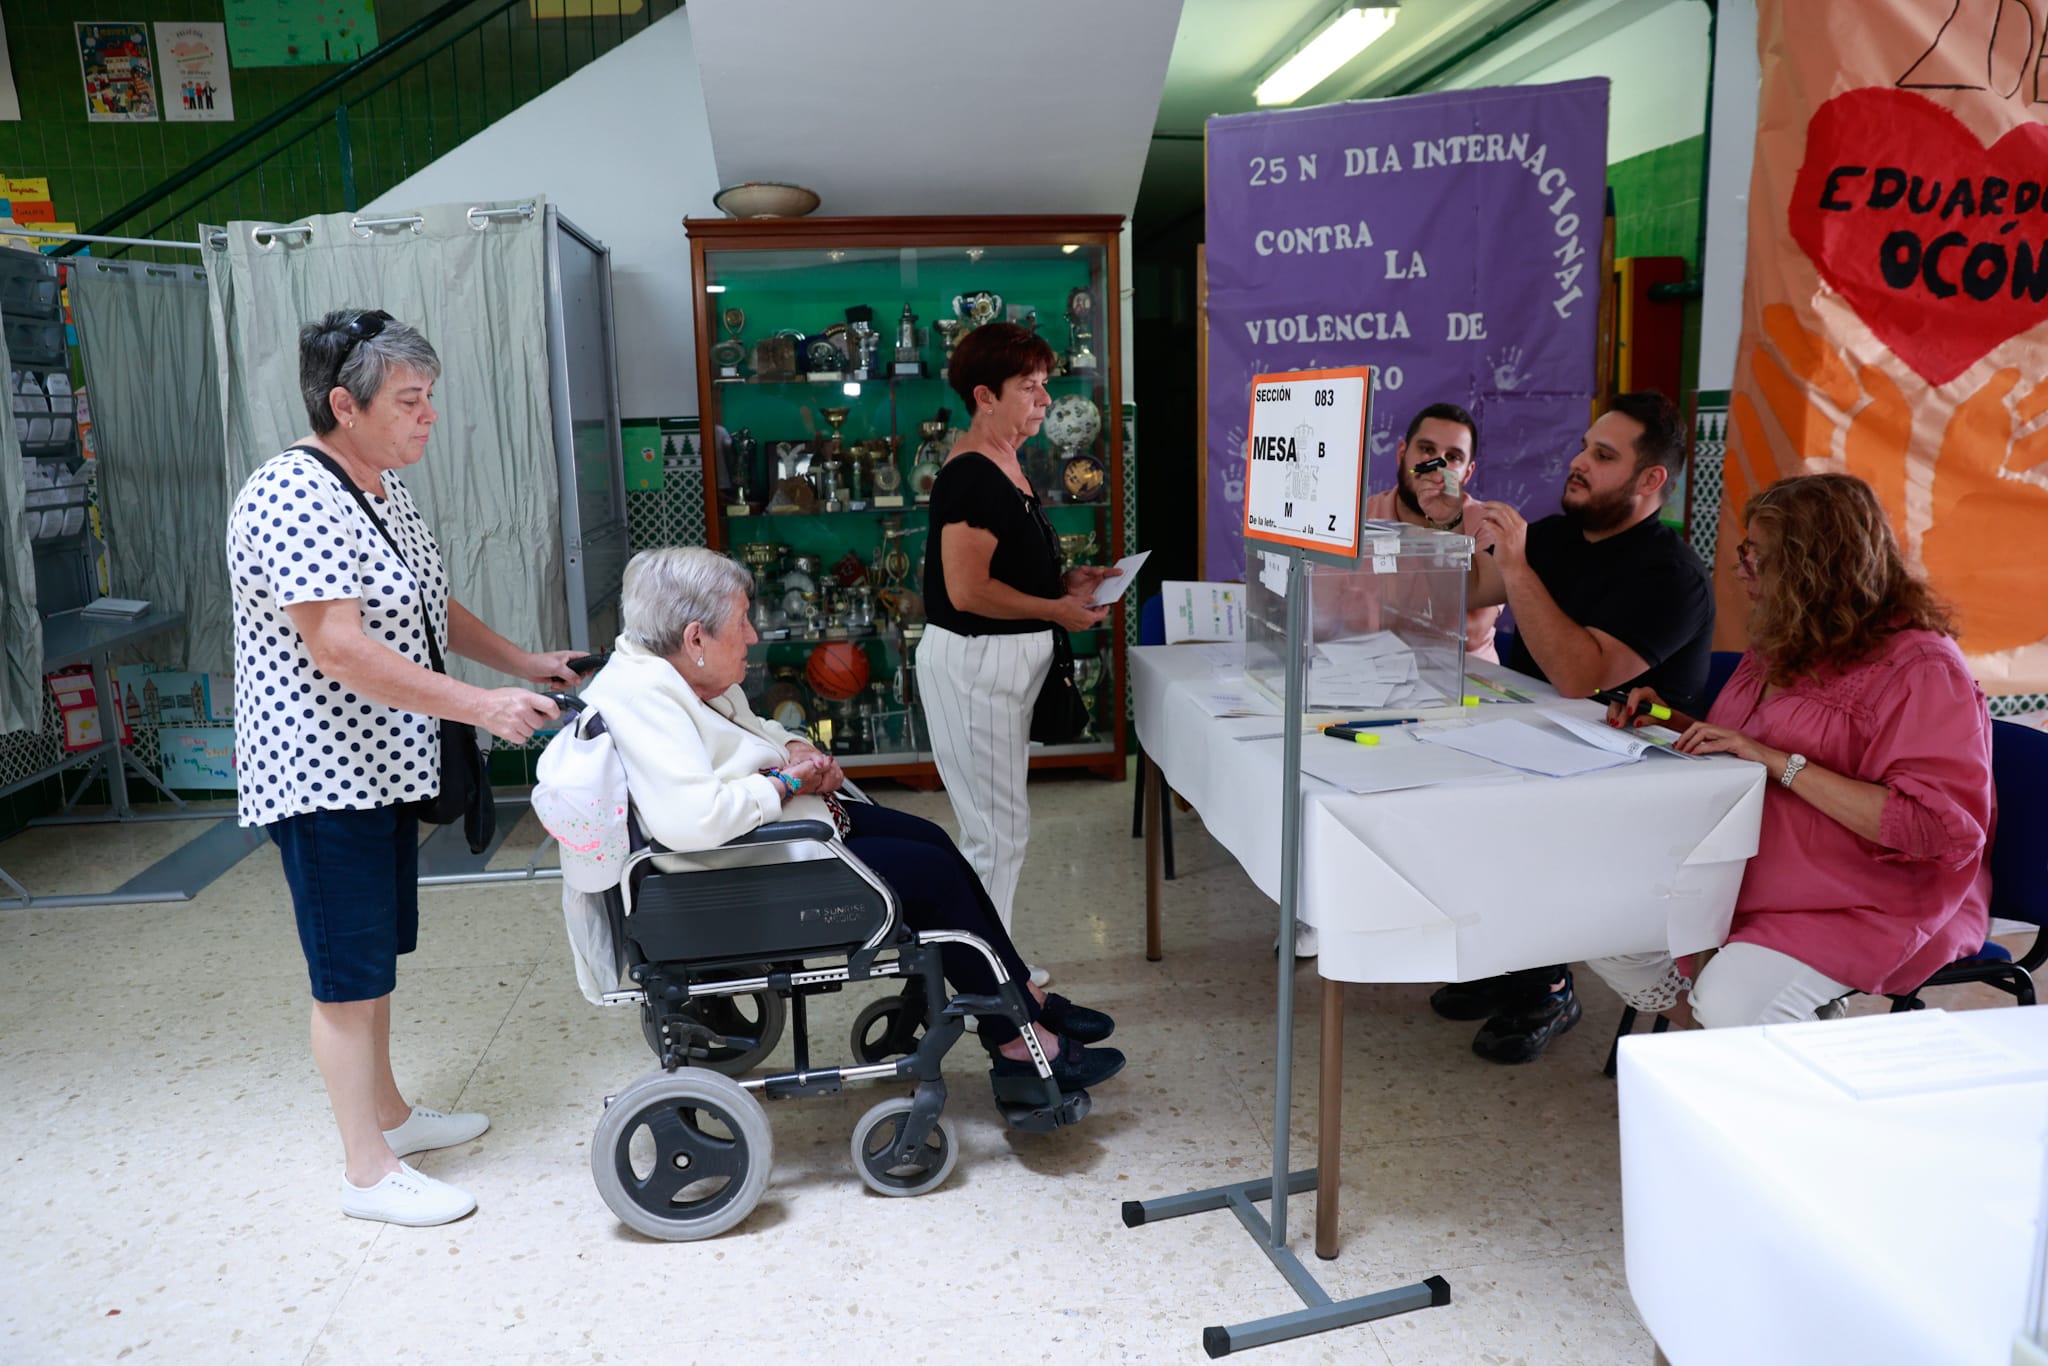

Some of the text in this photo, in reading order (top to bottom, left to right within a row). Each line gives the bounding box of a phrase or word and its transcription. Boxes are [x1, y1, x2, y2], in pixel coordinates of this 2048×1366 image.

[1819, 166, 2048, 220] EDUARD
[1248, 133, 1586, 319] 25 N DIA INTERNACIONAL
[1255, 220, 1374, 256] CONTRA
[1384, 250, 1428, 280] LA
[1245, 311, 1488, 345] VIOLENCIA DE
[1255, 385, 1335, 407] SECCIÓN 083
[1252, 436, 1326, 463] MESA B
[1284, 502, 1293, 518] M
[1327, 514, 1337, 532] Z
[823, 913, 867, 924] MEDICA
